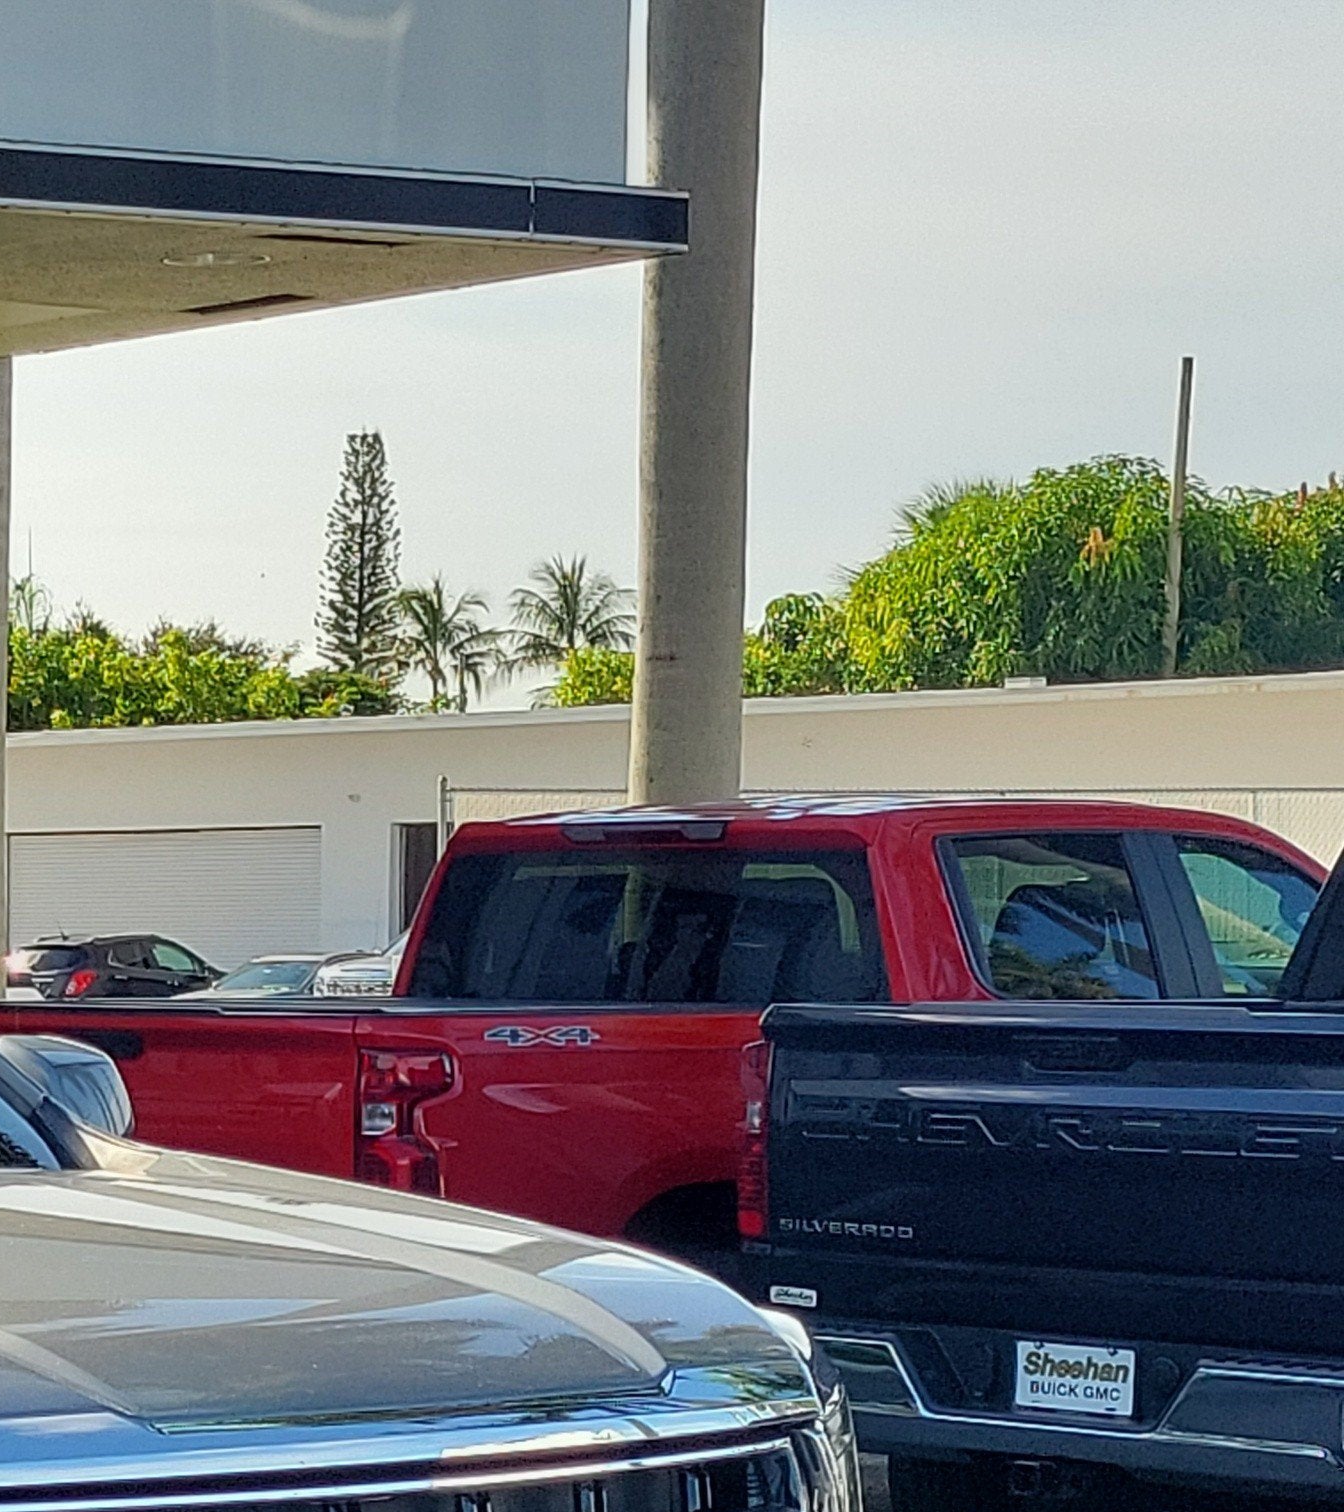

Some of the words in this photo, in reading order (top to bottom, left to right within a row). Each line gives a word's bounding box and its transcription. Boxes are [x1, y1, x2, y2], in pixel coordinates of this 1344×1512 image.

[779, 1218, 913, 1239] SILVERADO
[1023, 1351, 1129, 1383] Sheehan
[1030, 1381, 1078, 1398] BUICK
[1083, 1386, 1121, 1401] GMC
